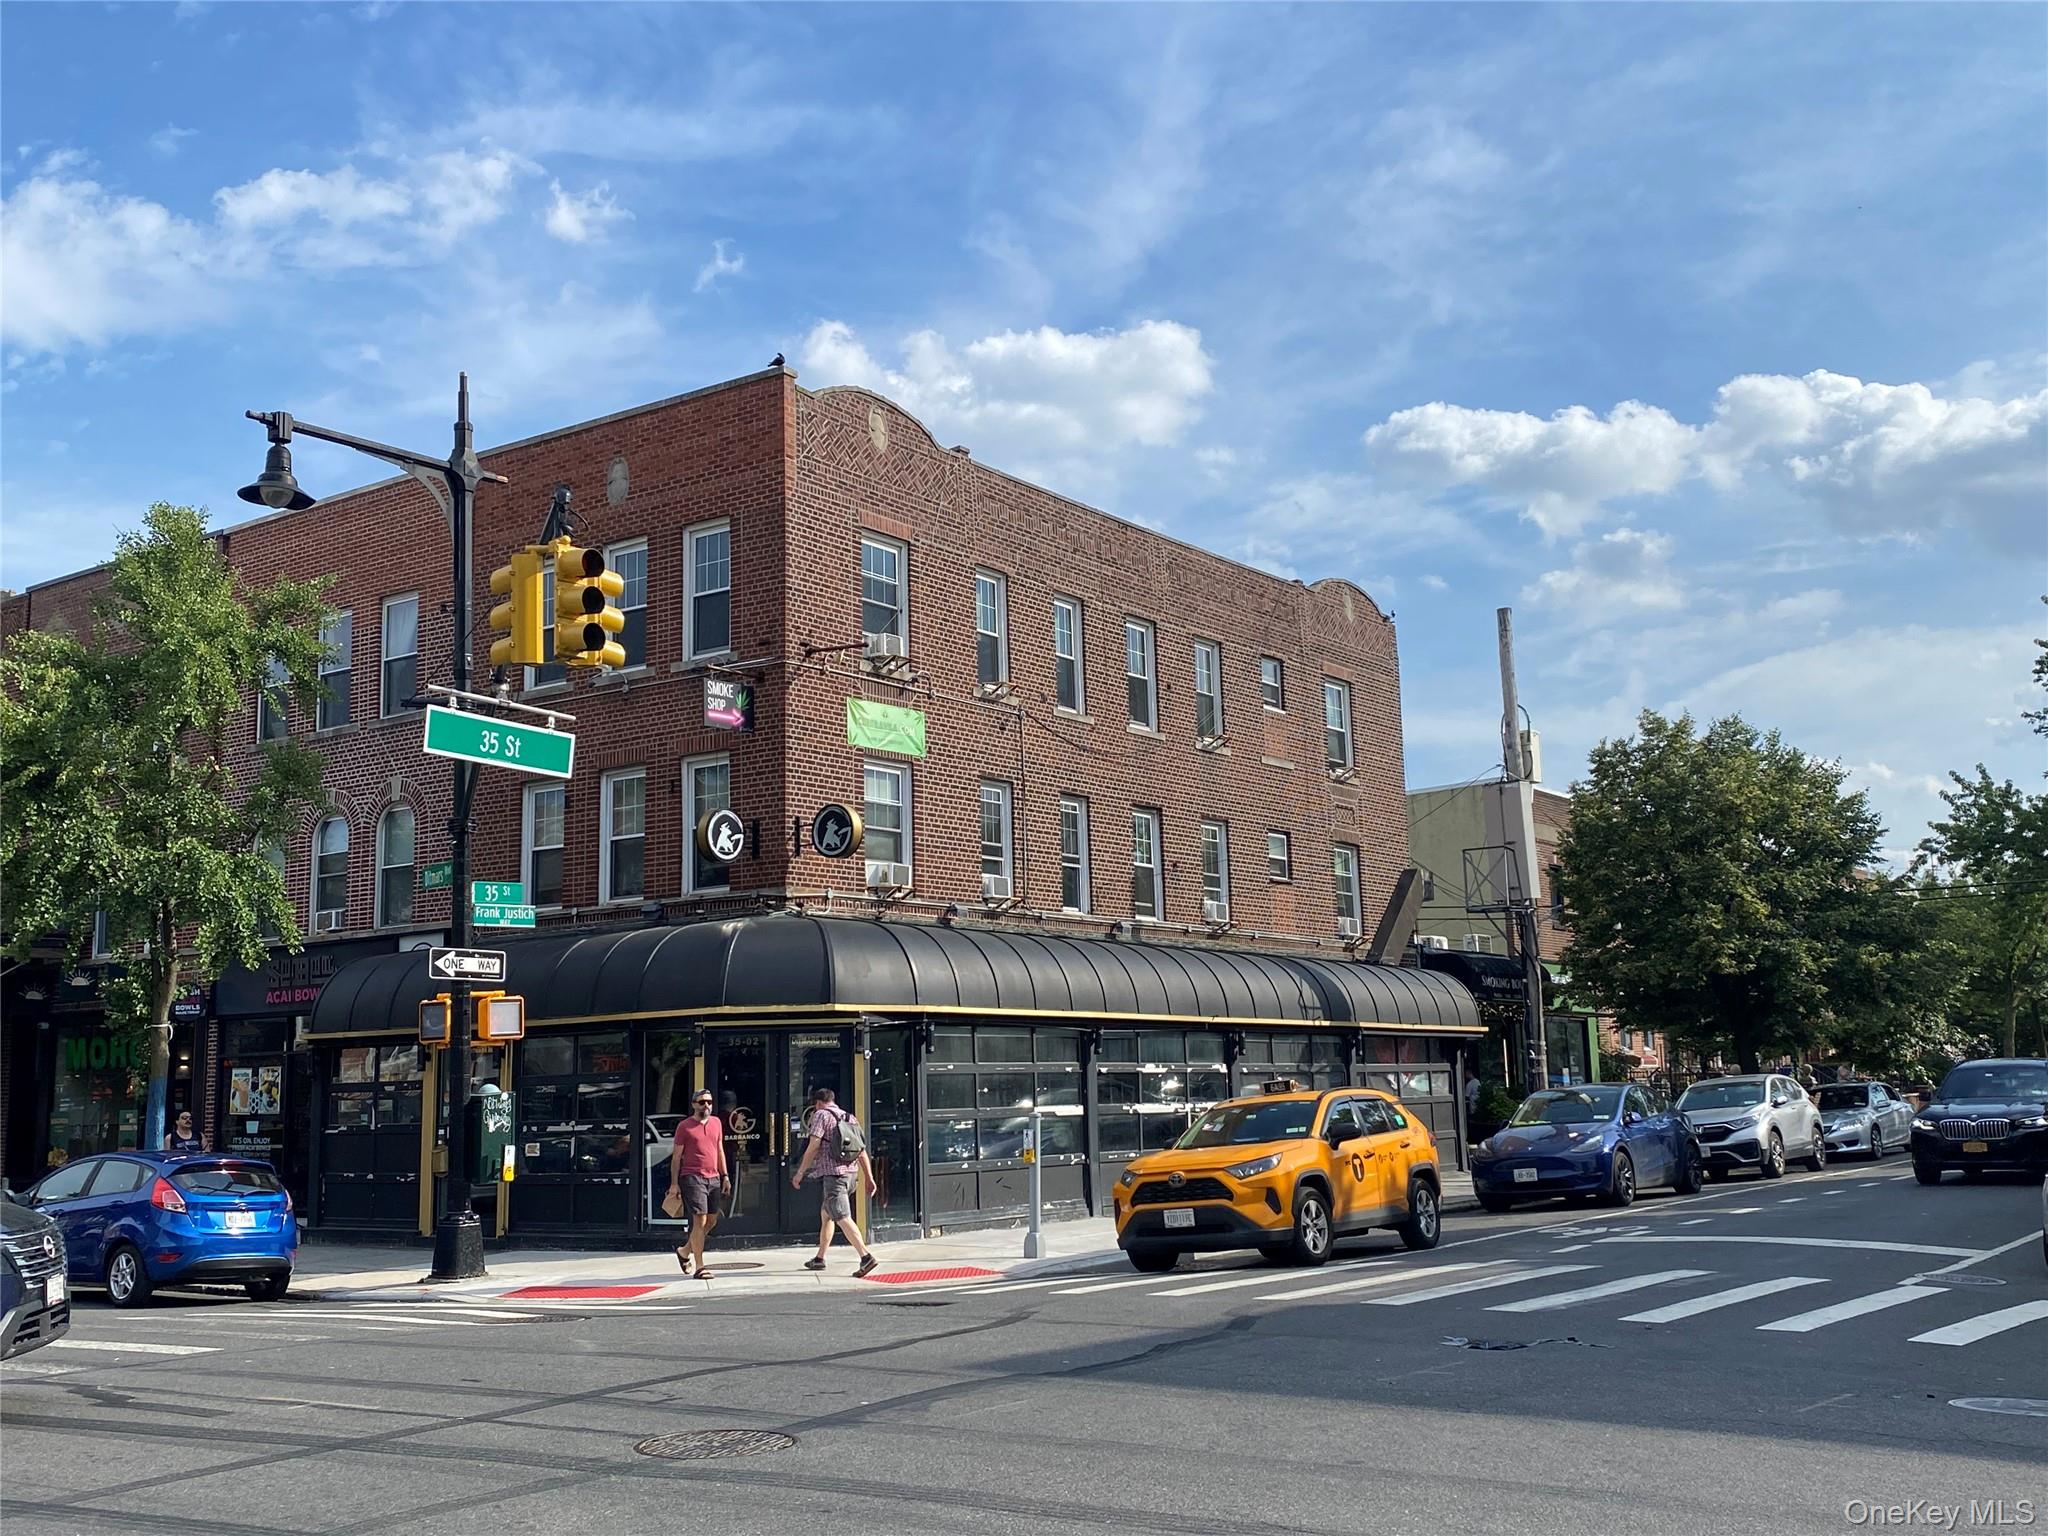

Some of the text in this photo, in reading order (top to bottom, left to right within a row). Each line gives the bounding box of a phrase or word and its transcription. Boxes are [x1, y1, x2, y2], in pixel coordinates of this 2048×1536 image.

[707, 680, 734, 698] SMOKE
[707, 697, 726, 711] SHOP
[479, 730, 521, 758] 35 St
[485, 885, 511, 901] 35 St
[475, 907, 534, 919] Frank Justich
[443, 958, 497, 971] ONE WAY
[1481, 975, 1510, 989] SMOKING
[266, 989, 291, 1004] ACAI
[728, 1037, 759, 1046] 35-02
